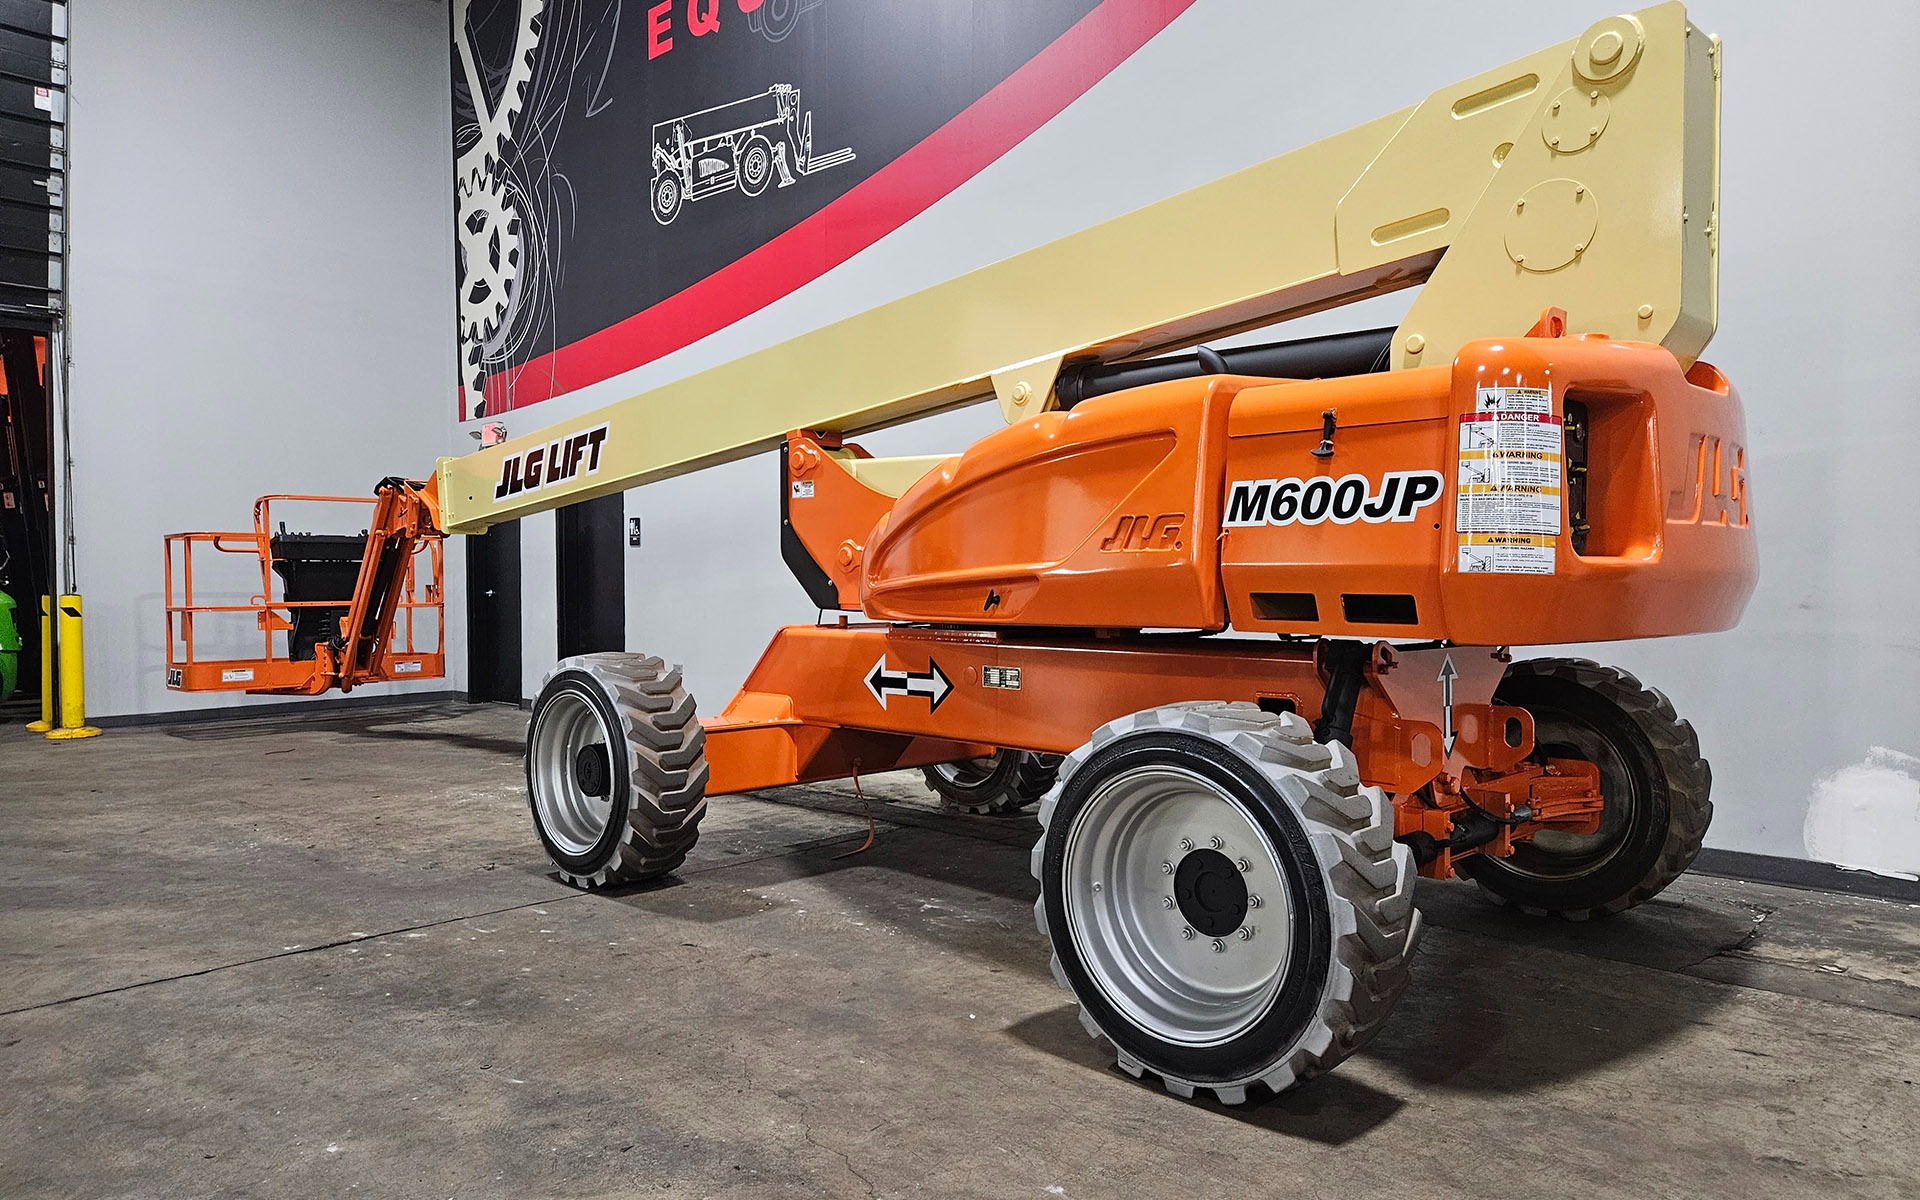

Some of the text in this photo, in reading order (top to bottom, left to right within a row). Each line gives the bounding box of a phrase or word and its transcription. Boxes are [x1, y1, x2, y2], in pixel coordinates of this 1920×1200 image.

[648, 0, 764, 60] EQ
[1500, 413, 1540, 421] DANGER
[495, 426, 607, 499] JLG LIFT
[1500, 451, 1543, 459] WARNING
[1500, 484, 1542, 493] WARNING
[1227, 475, 1439, 522] M600JP
[167, 669, 182, 687] JLG
